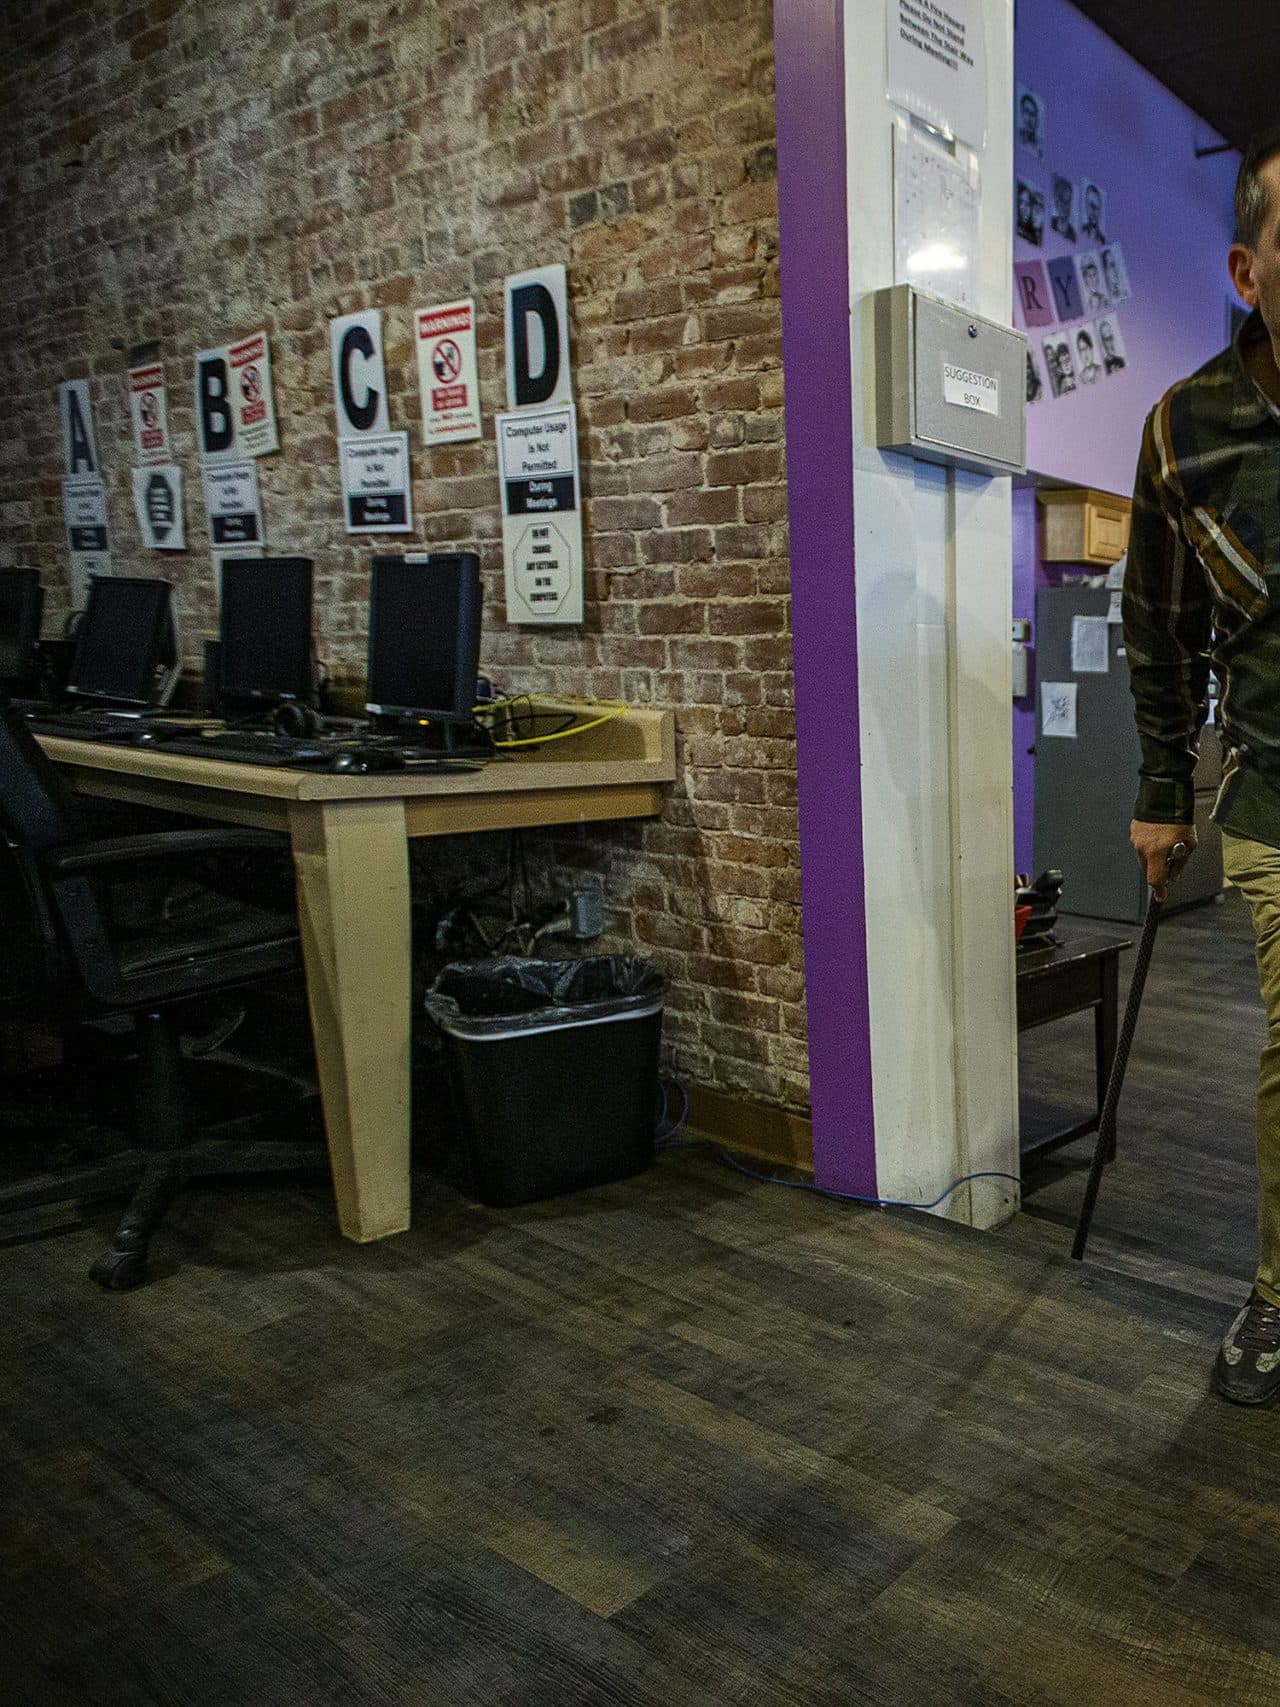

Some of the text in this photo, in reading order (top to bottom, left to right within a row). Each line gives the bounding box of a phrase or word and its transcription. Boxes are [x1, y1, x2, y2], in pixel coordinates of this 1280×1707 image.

[511, 285, 560, 406] D
[341, 326, 379, 430] C
[945, 366, 997, 391] SUGGESTION
[199, 358, 235, 452] B
[964, 393, 981, 407] BOX
[67, 389, 95, 474] A
[506, 422, 567, 438] Computer Usage
[536, 442, 550, 452] Not
[522, 460, 557, 471] Permitted
[529, 480, 553, 493] During
